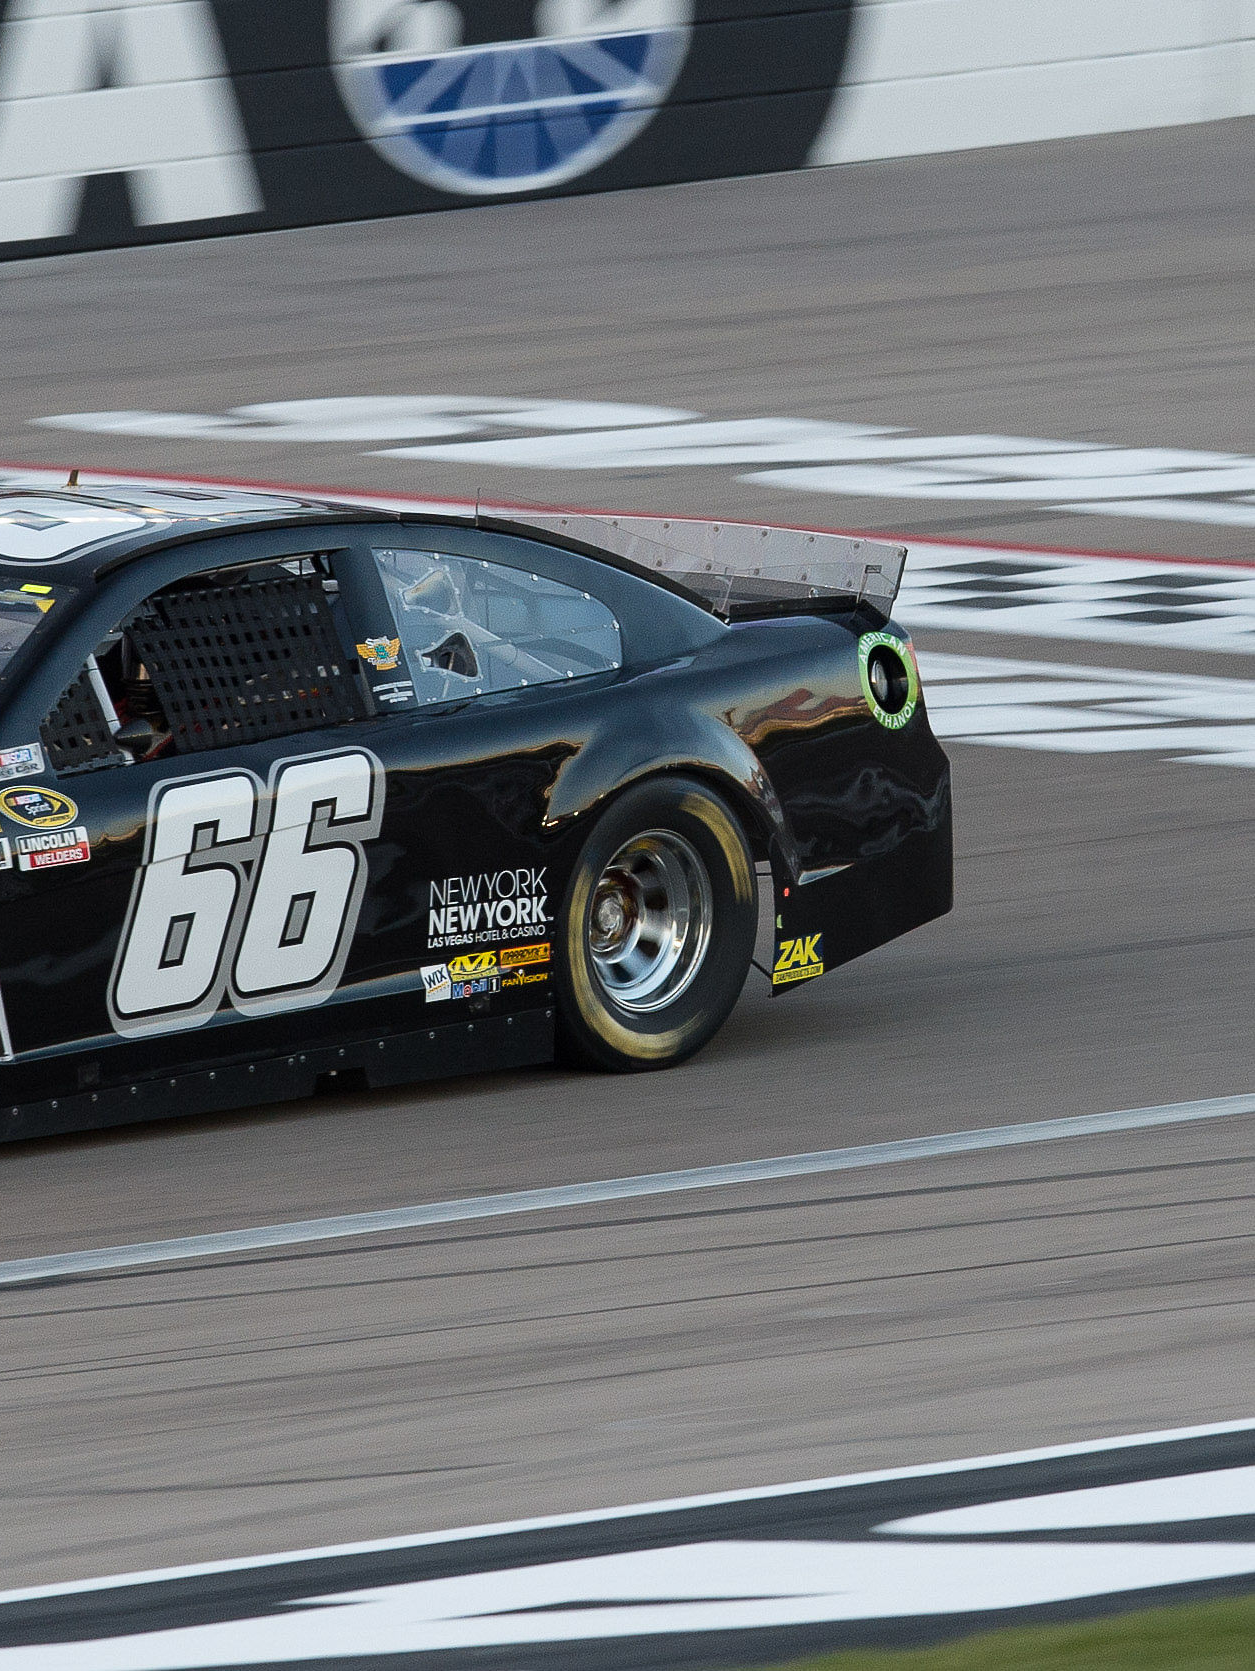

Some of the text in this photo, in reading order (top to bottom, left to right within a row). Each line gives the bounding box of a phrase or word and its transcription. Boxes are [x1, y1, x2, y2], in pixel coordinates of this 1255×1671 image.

[859, 633, 906, 664] AMERICAN
[873, 701, 915, 728] ETHANOL
[15, 763, 39, 776] CAR
[19, 831, 77, 853] LINCOLN
[34, 848, 84, 866] WELDERS
[107, 747, 383, 1037] 66
[429, 866, 547, 907] NEW YORK
[428, 896, 548, 936] NEW YORK
[427, 924, 546, 949] LAS VEGAS HOTEL & CASINO
[774, 932, 822, 971] ZAK
[425, 967, 447, 989] WIX
[452, 980, 488, 1000] Mobil
[489, 977, 501, 993] 1
